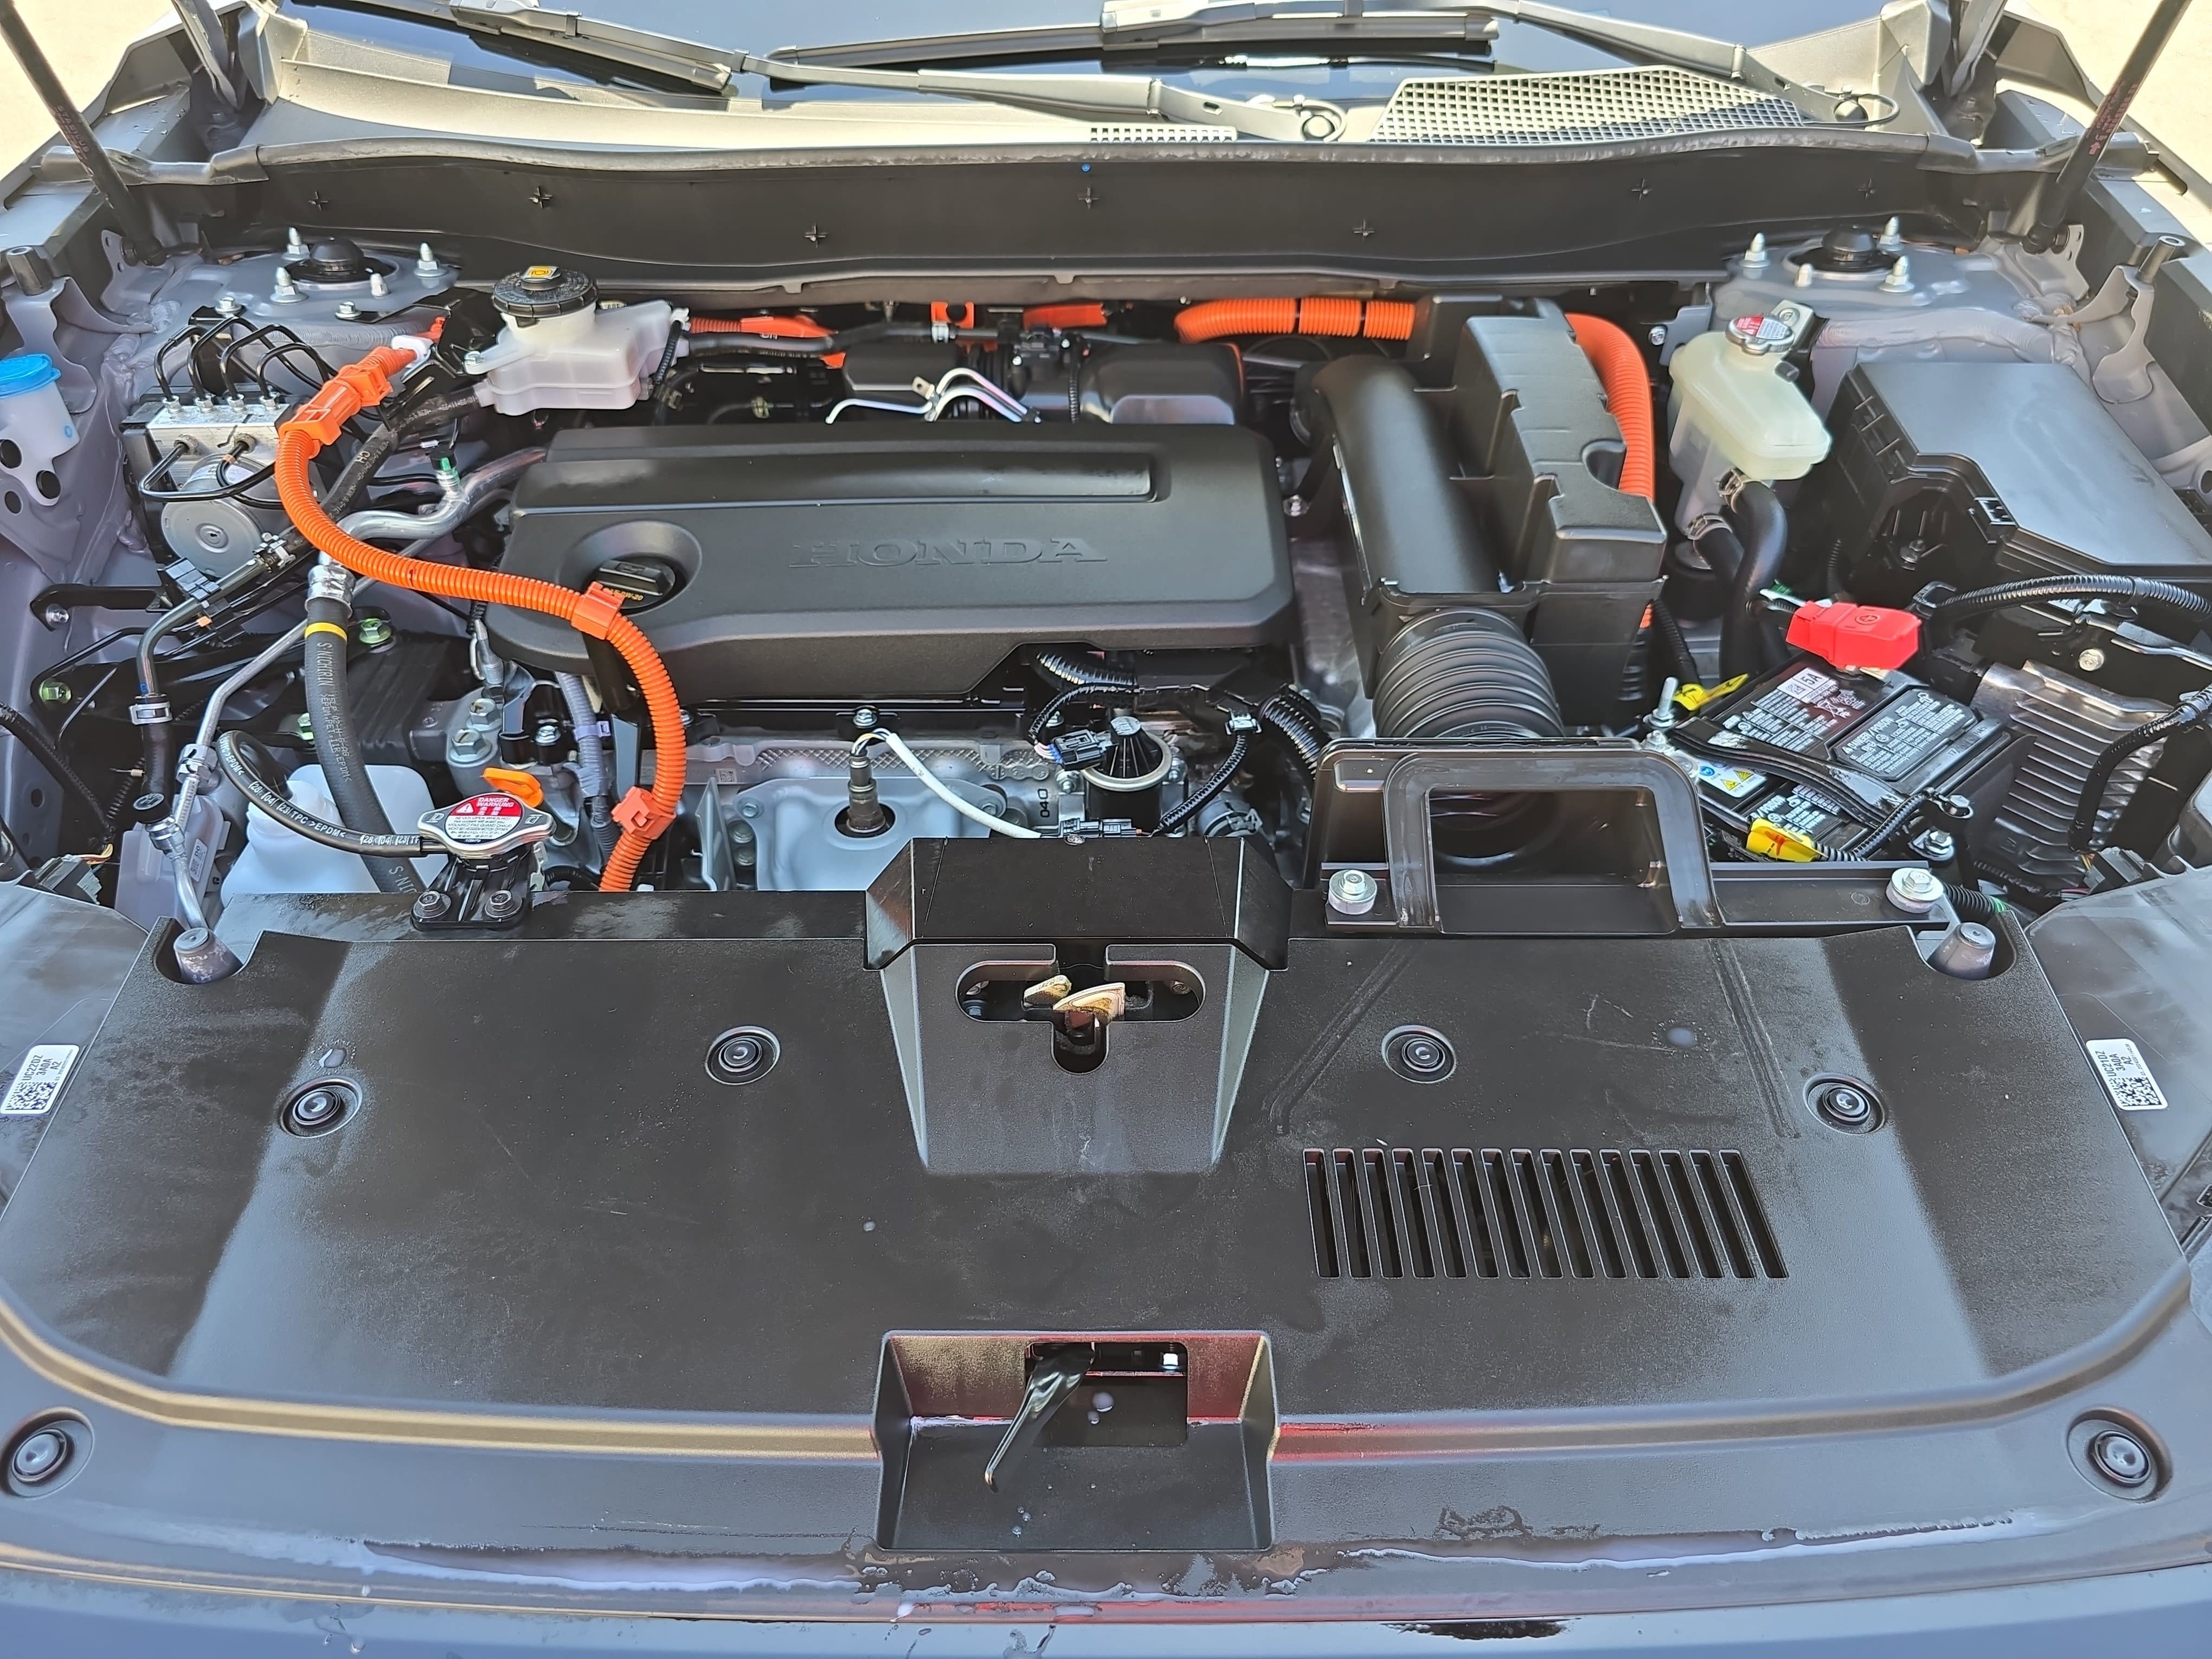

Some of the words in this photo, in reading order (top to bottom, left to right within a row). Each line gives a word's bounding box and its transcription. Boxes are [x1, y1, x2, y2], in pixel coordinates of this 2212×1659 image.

[788, 537, 1108, 568] HONDA
[1800, 673, 1823, 685] 5A
[1037, 788, 1050, 818] 040
[21, 1054, 44, 1081] UC22DZ
[49, 1061, 62, 1070] A2
[2094, 1050, 2117, 1077] UC21DZ
[2121, 1056, 2134, 1065] A2
